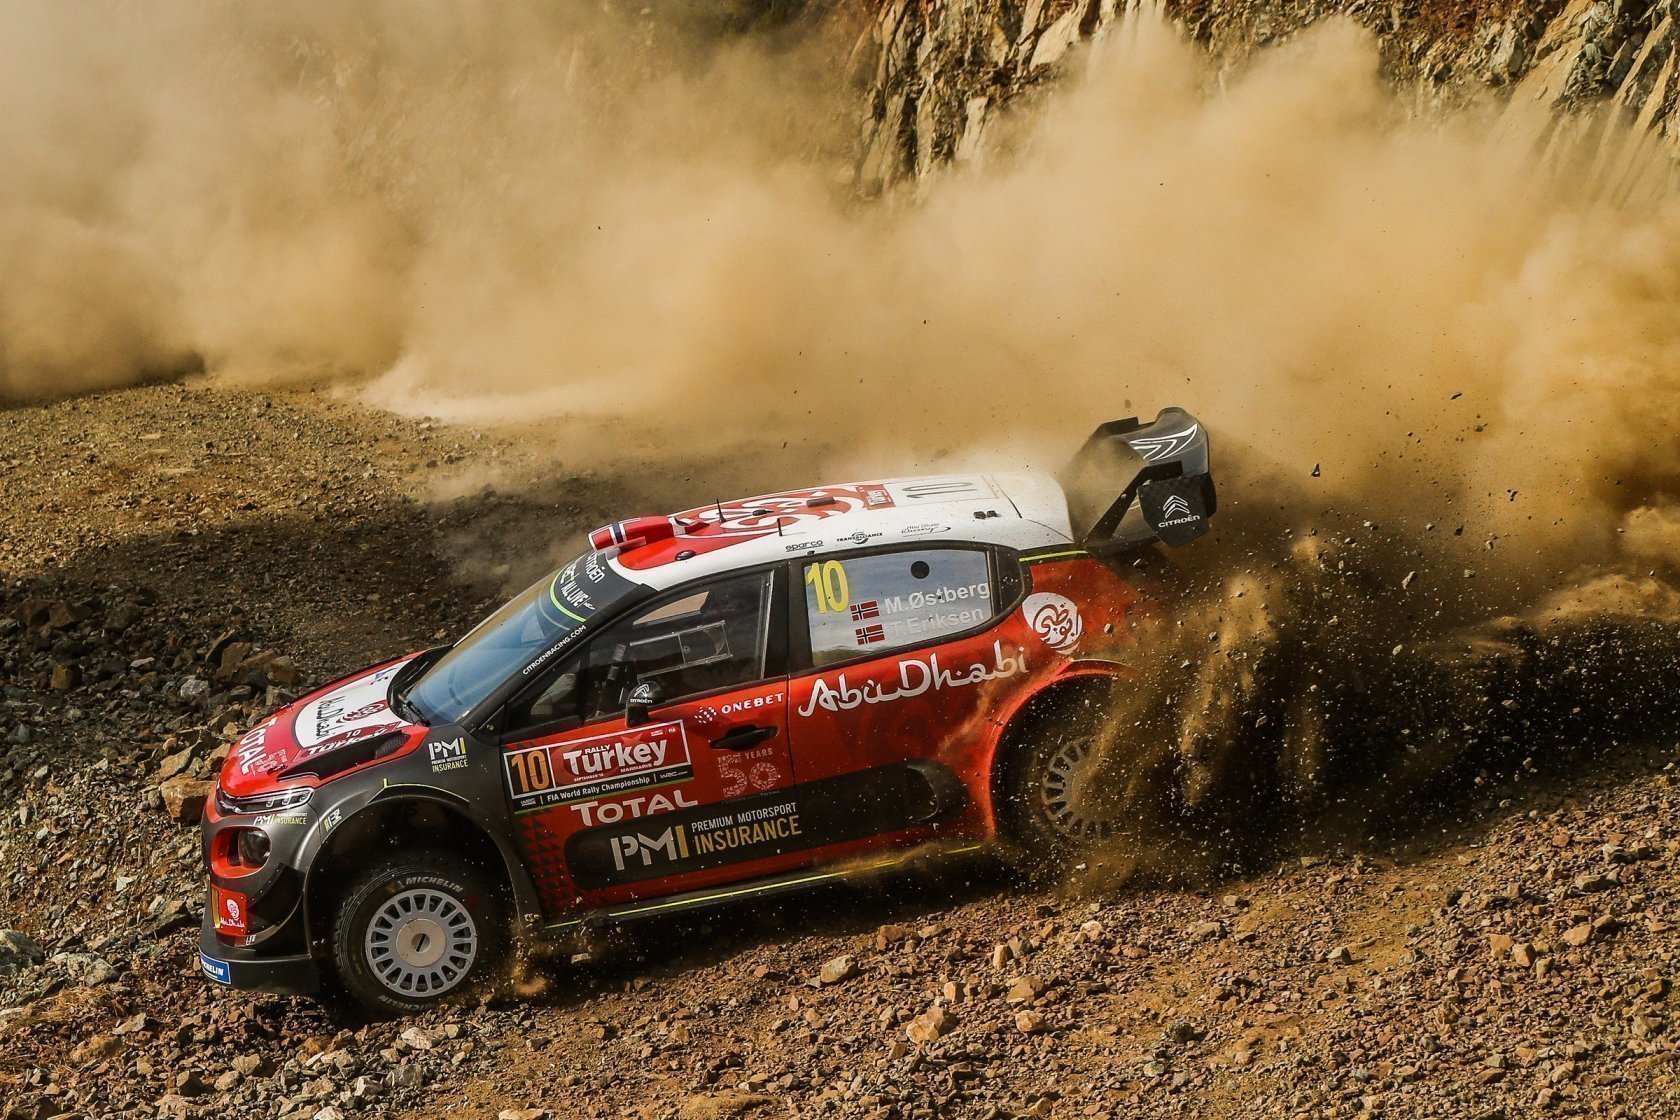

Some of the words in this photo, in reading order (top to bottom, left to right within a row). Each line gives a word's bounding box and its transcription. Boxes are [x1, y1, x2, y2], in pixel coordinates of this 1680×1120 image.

[785, 539, 824, 552] sparco
[836, 531, 883, 543] TRANSALLIANCE
[805, 559, 849, 614] 10
[885, 581, 990, 616] M.Østberg
[890, 606, 985, 638] T.Eriksen
[522, 625, 587, 675] CITROENRACING.COM
[798, 672, 900, 717] Abu
[898, 639, 1030, 698] Dhabi
[721, 692, 785, 714] ONEBET
[238, 716, 278, 775] TOTAL
[428, 737, 466, 760] PMI
[563, 740, 667, 775] Turkey
[584, 744, 611, 755] RALLY
[744, 747, 773, 760] YEARS
[432, 759, 469, 773] INSURANCE
[511, 750, 550, 793] 10
[547, 793, 560, 802] FIA
[560, 788, 581, 800] World
[582, 785, 600, 797] Rally
[601, 775, 650, 793] Championship
[571, 789, 698, 827] TOTAL
[691, 815, 734, 833] PREMIUM
[737, 802, 798, 822] MOTORSPORT
[610, 824, 690, 871] PMI
[694, 815, 802, 855] INSURANCE
[405, 876, 464, 893] MICHELIN
